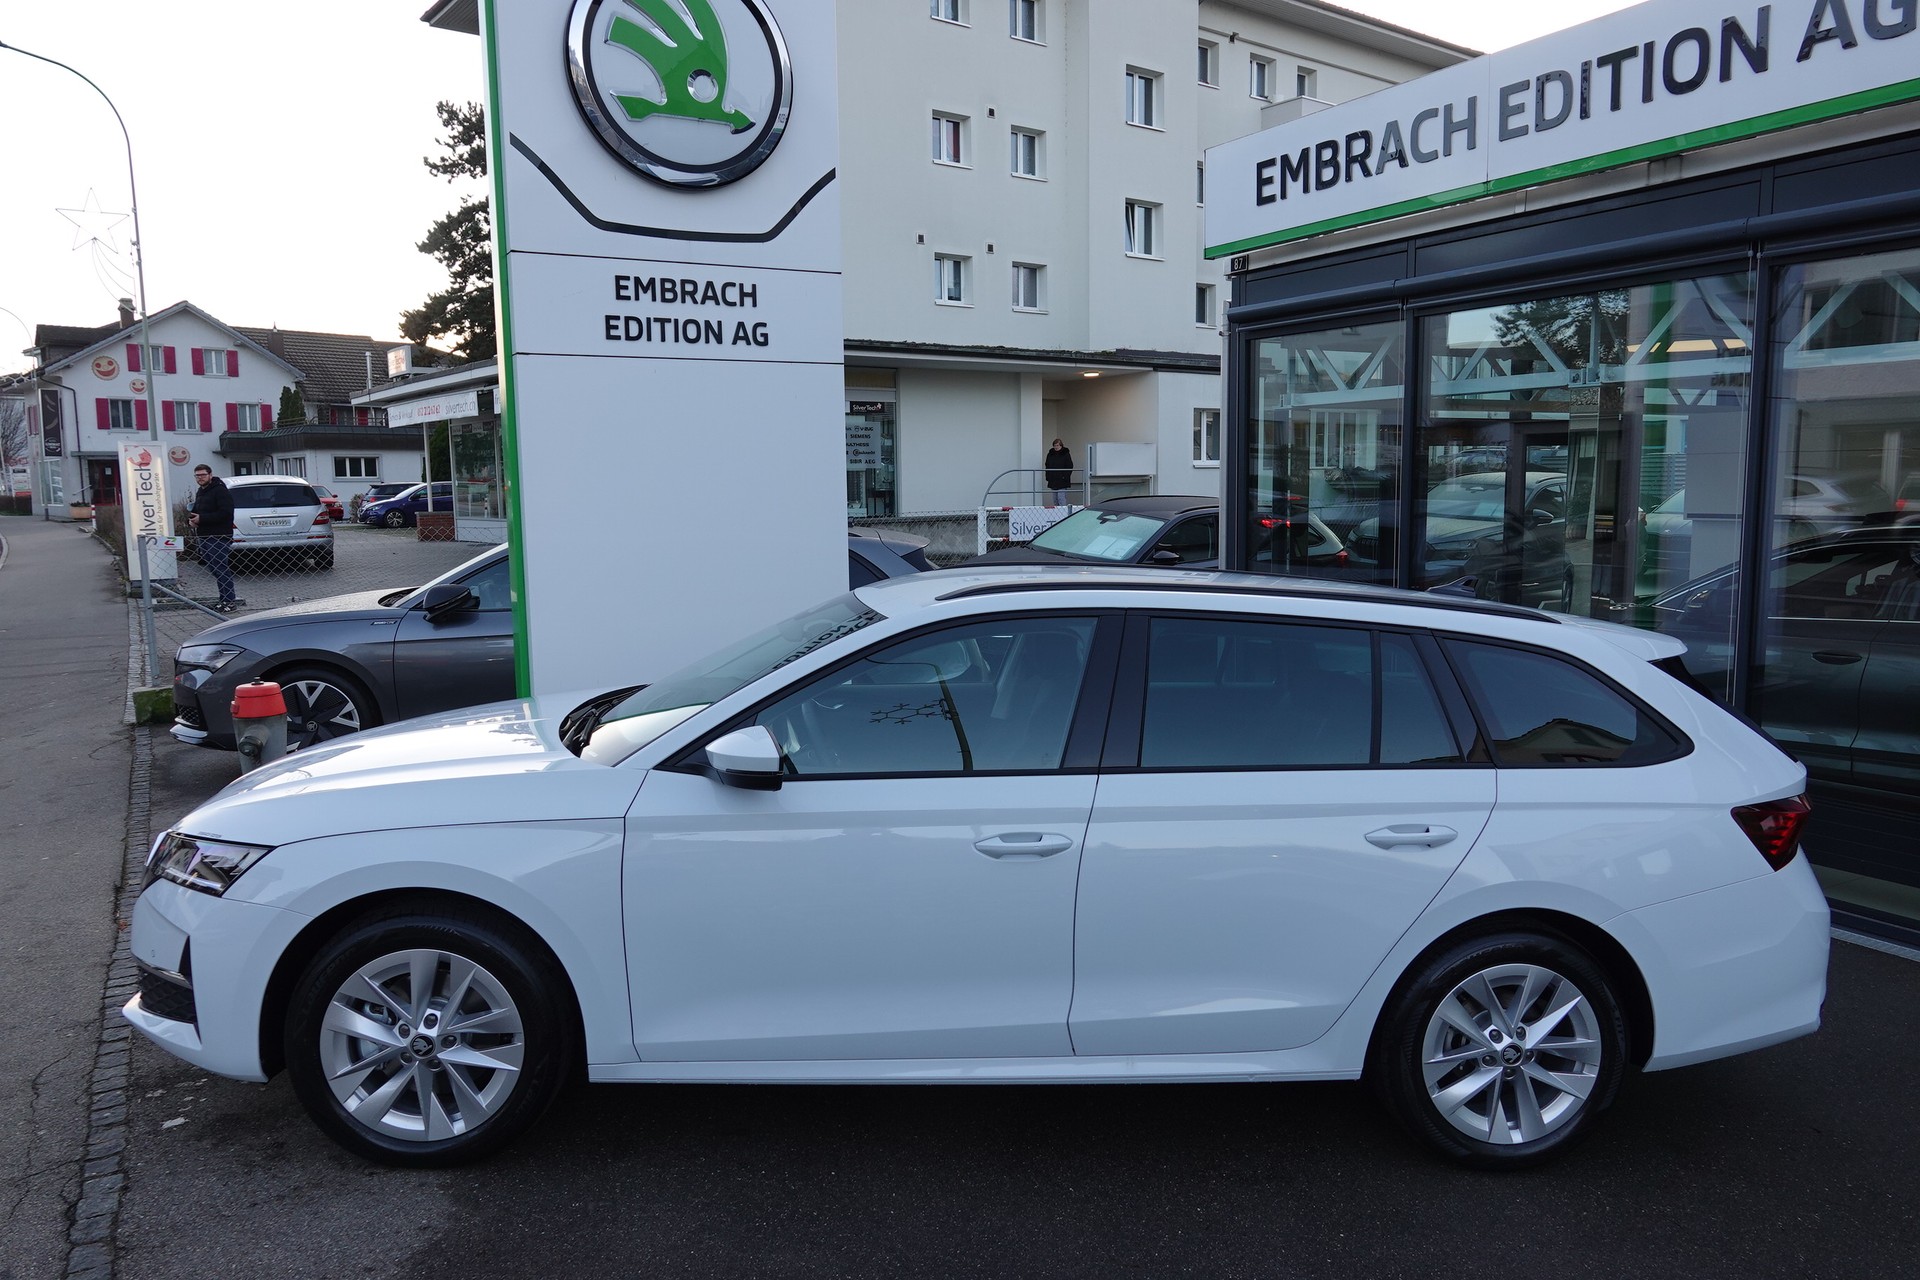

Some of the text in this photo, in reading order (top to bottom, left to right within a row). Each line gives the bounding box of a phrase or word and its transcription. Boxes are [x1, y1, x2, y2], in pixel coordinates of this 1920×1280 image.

[1256, 0, 1918, 207] EMBRACH EDITION AG
[1234, 257, 1244, 270] 87
[614, 274, 758, 308] EMBRACH
[604, 314, 769, 347] EDITION AG
